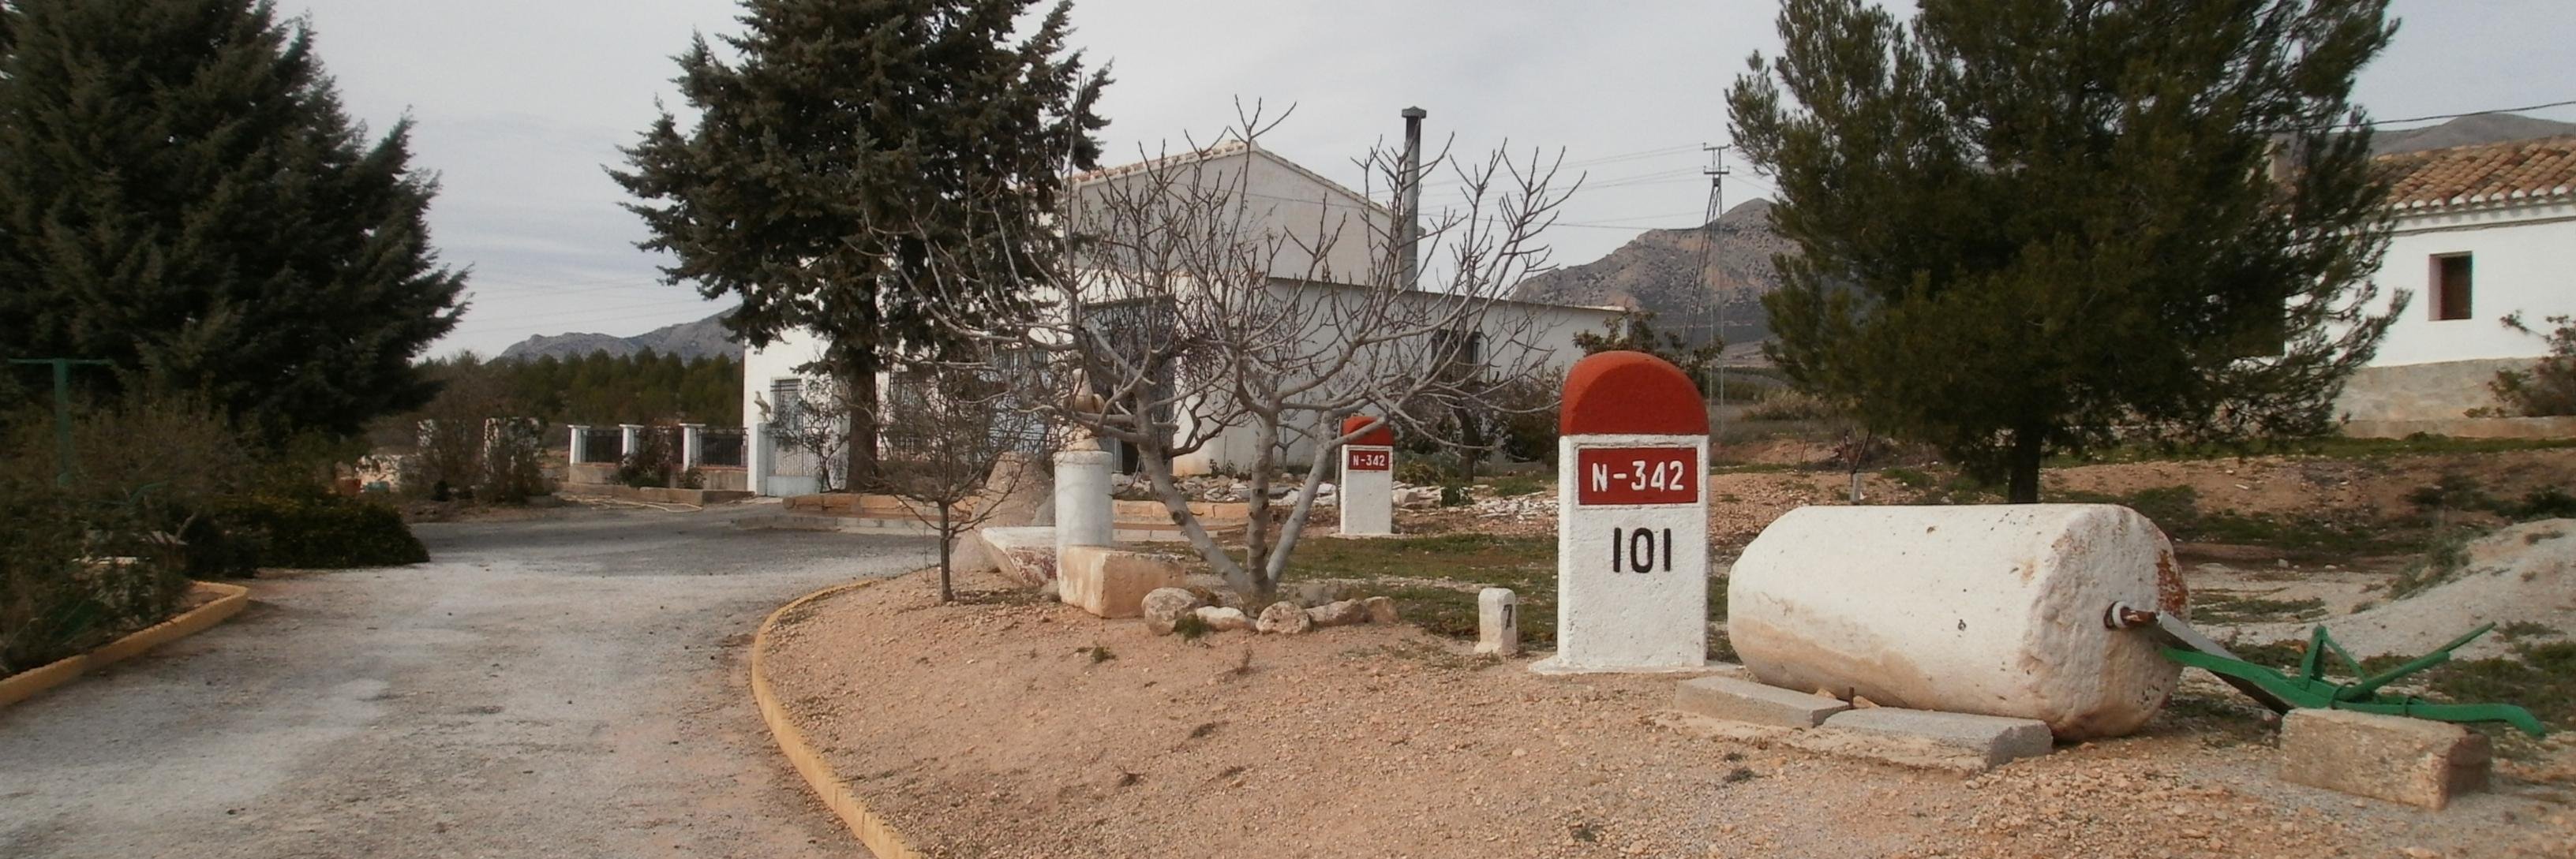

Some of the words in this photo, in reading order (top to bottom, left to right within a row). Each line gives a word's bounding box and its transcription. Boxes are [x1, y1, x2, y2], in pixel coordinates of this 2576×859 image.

[1353, 454, 1385, 466] N-342
[1592, 460, 1684, 492] N-342
[1613, 527, 1672, 573] 101
